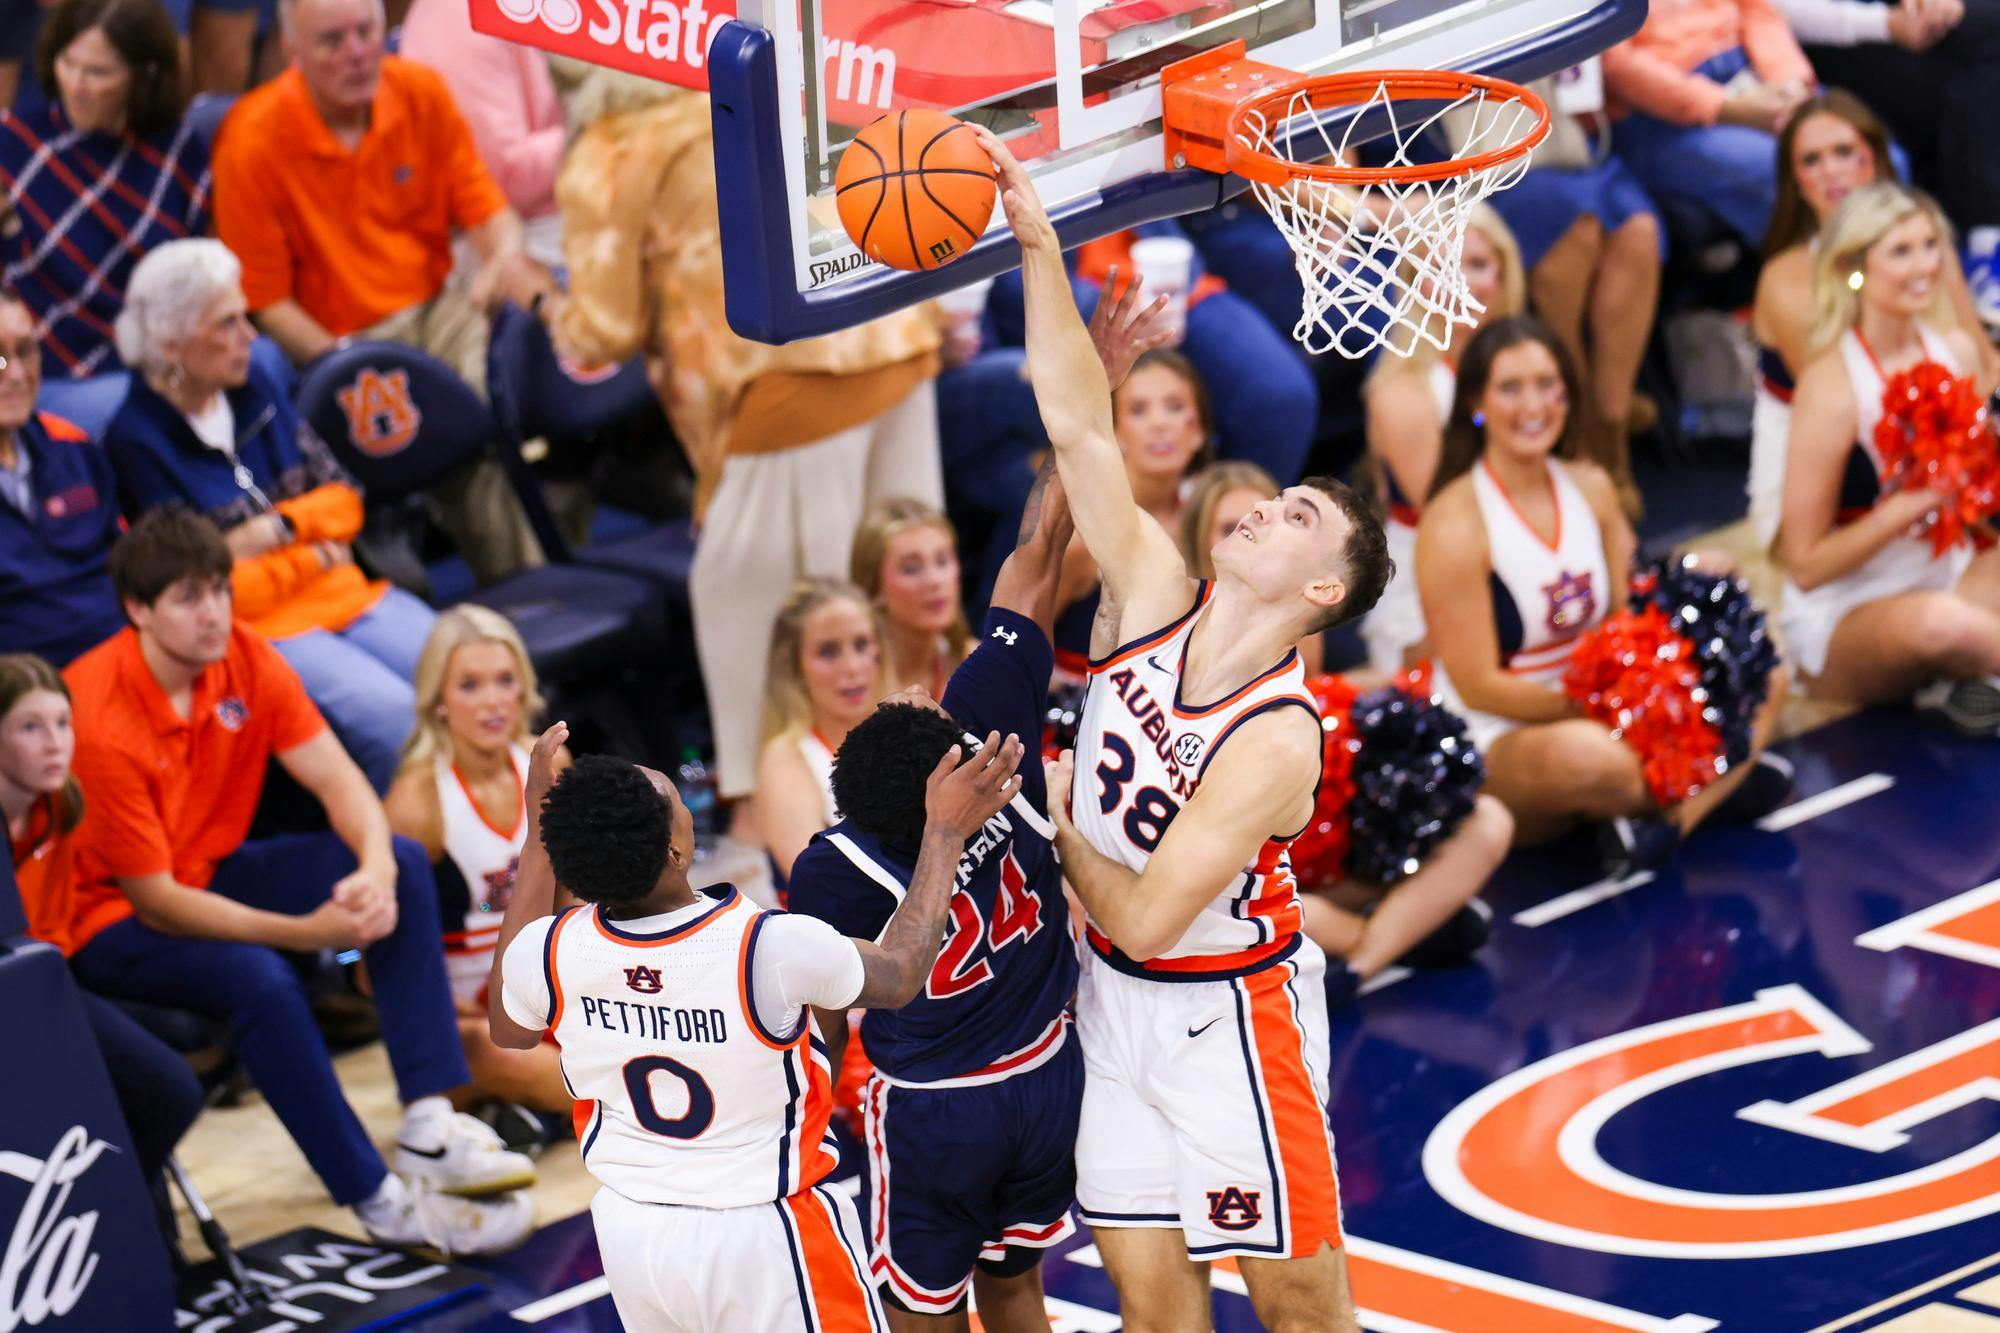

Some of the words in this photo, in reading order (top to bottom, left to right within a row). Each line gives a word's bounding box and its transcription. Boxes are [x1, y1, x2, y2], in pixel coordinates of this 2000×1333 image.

[822, 35, 897, 110] rm
[808, 252, 876, 289] SPALDI
[1110, 667, 1200, 801] AUBURN
[1096, 731, 1181, 854] 38
[953, 811, 1013, 895] FFIN
[925, 839, 1044, 999] 24
[581, 996, 727, 1043] PETTIFORD
[622, 1055, 715, 1140] 0
